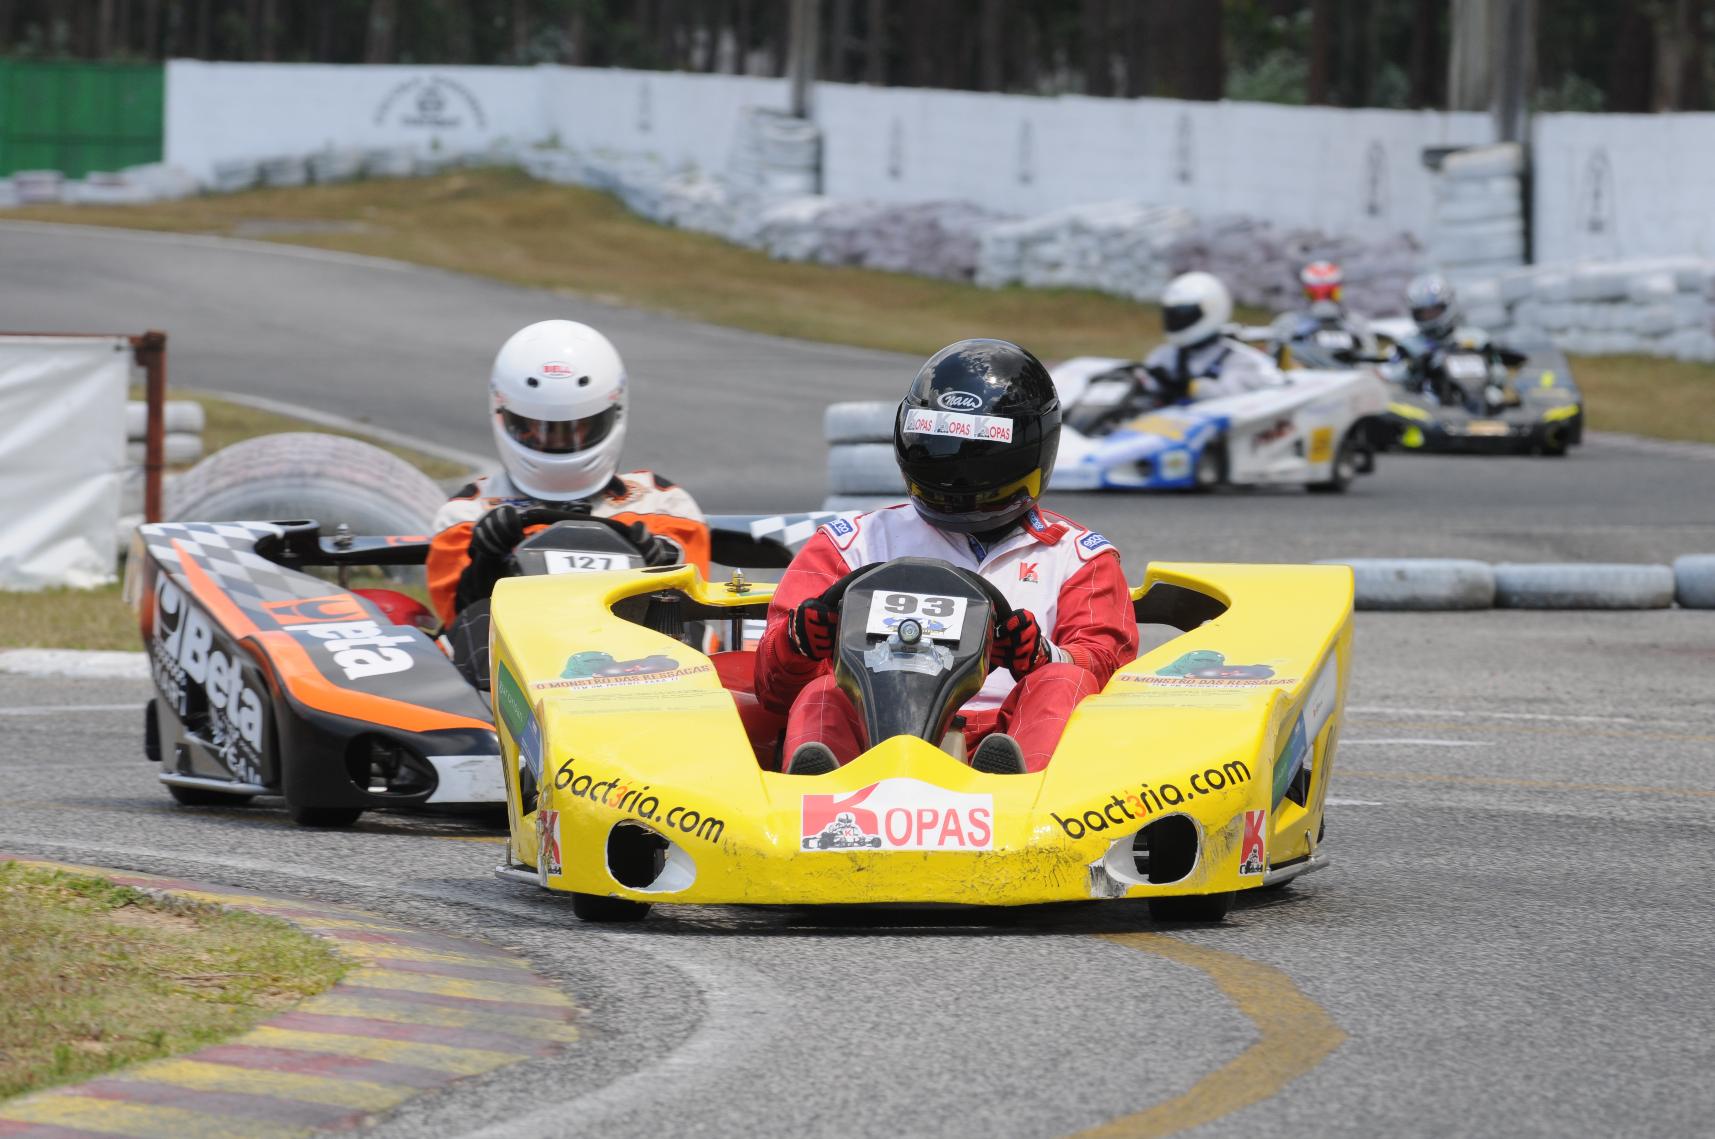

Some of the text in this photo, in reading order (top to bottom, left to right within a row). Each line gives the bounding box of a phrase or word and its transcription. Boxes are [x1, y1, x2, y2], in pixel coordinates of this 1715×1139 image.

[562, 555, 613, 571] 127
[884, 593, 956, 618] 93
[180, 607, 263, 753] Beta
